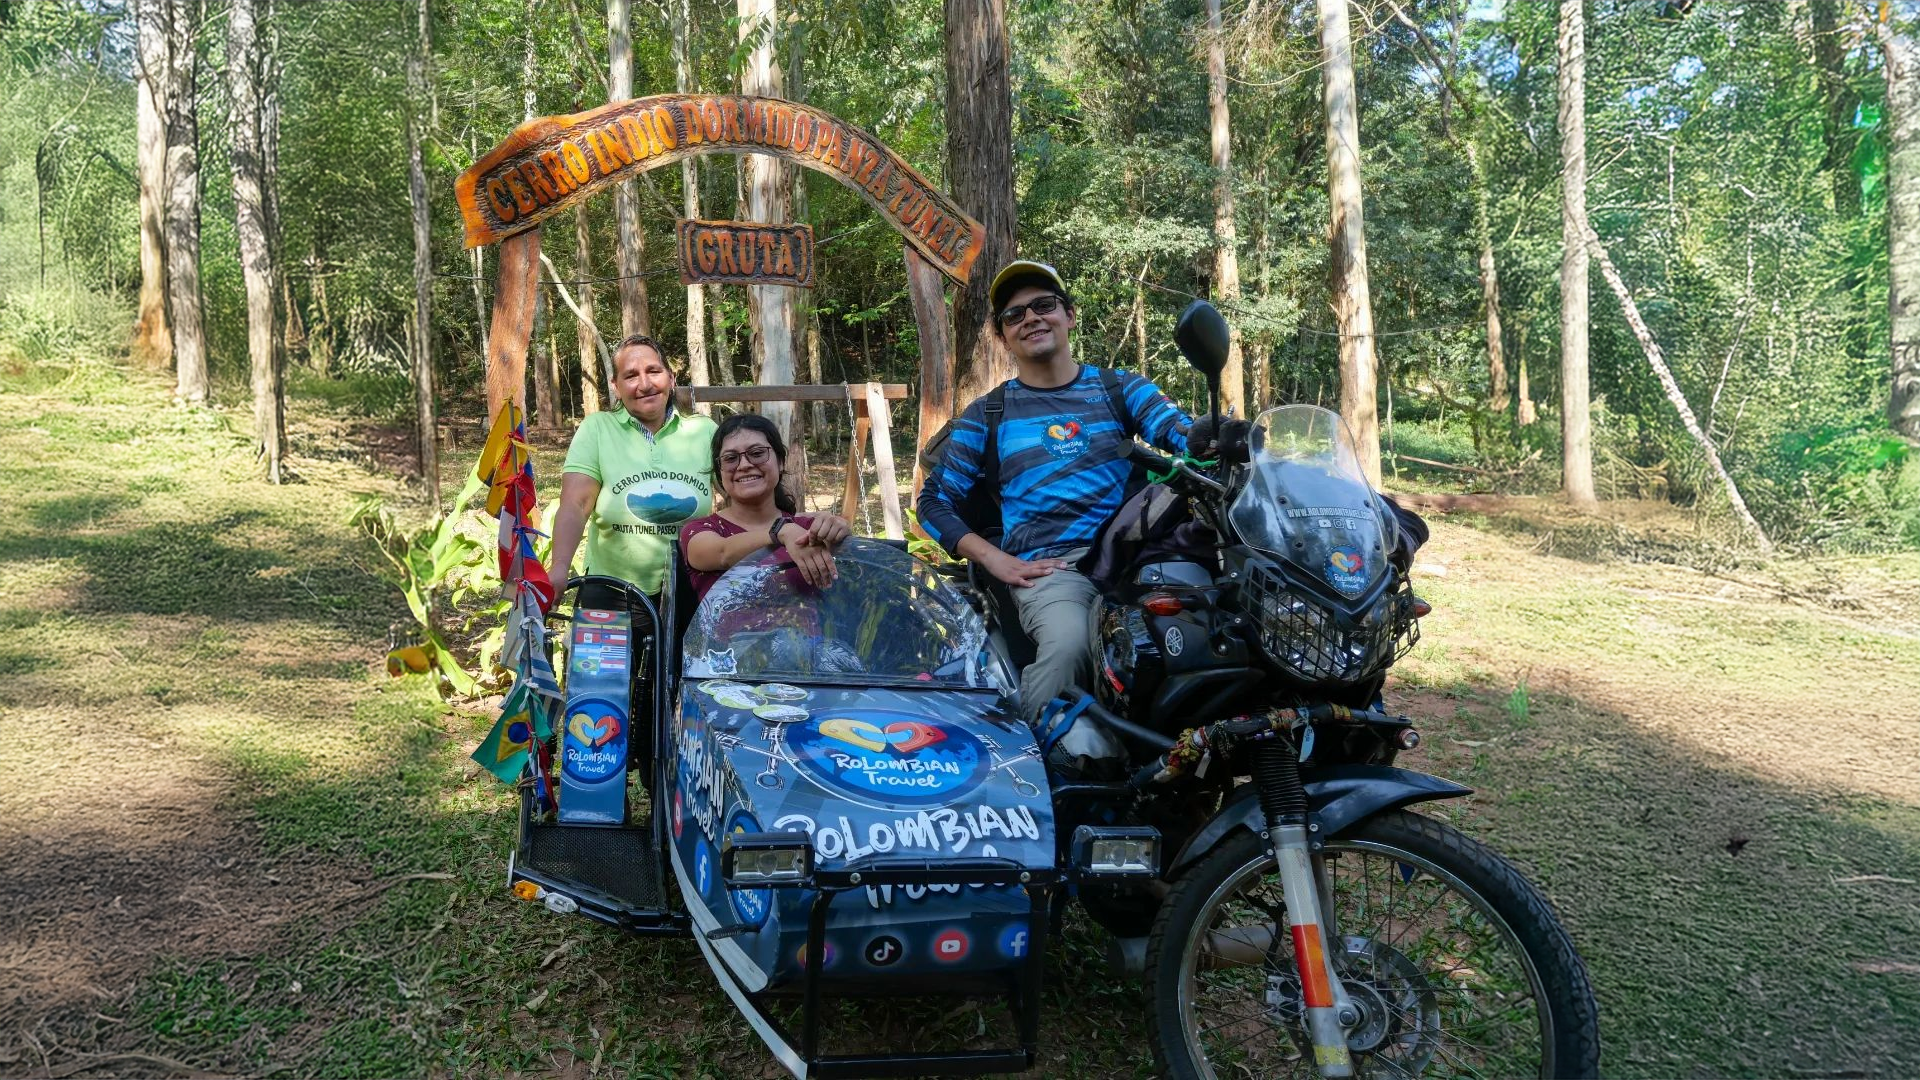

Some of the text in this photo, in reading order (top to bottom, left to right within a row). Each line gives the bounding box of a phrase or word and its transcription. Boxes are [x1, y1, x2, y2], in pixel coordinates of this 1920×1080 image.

[486, 141, 590, 222] CERRO
[586, 105, 678, 175] INDIO
[680, 99, 811, 153] DORMIDO
[888, 176, 963, 263] TUNEL
[612, 470, 709, 497] CERRO INDIO DORMIDO
[634, 525, 656, 536] TUNEL
[656, 525, 677, 536] PASEO
[577, 761, 607, 774] Travel
[862, 770, 943, 788] Travel
